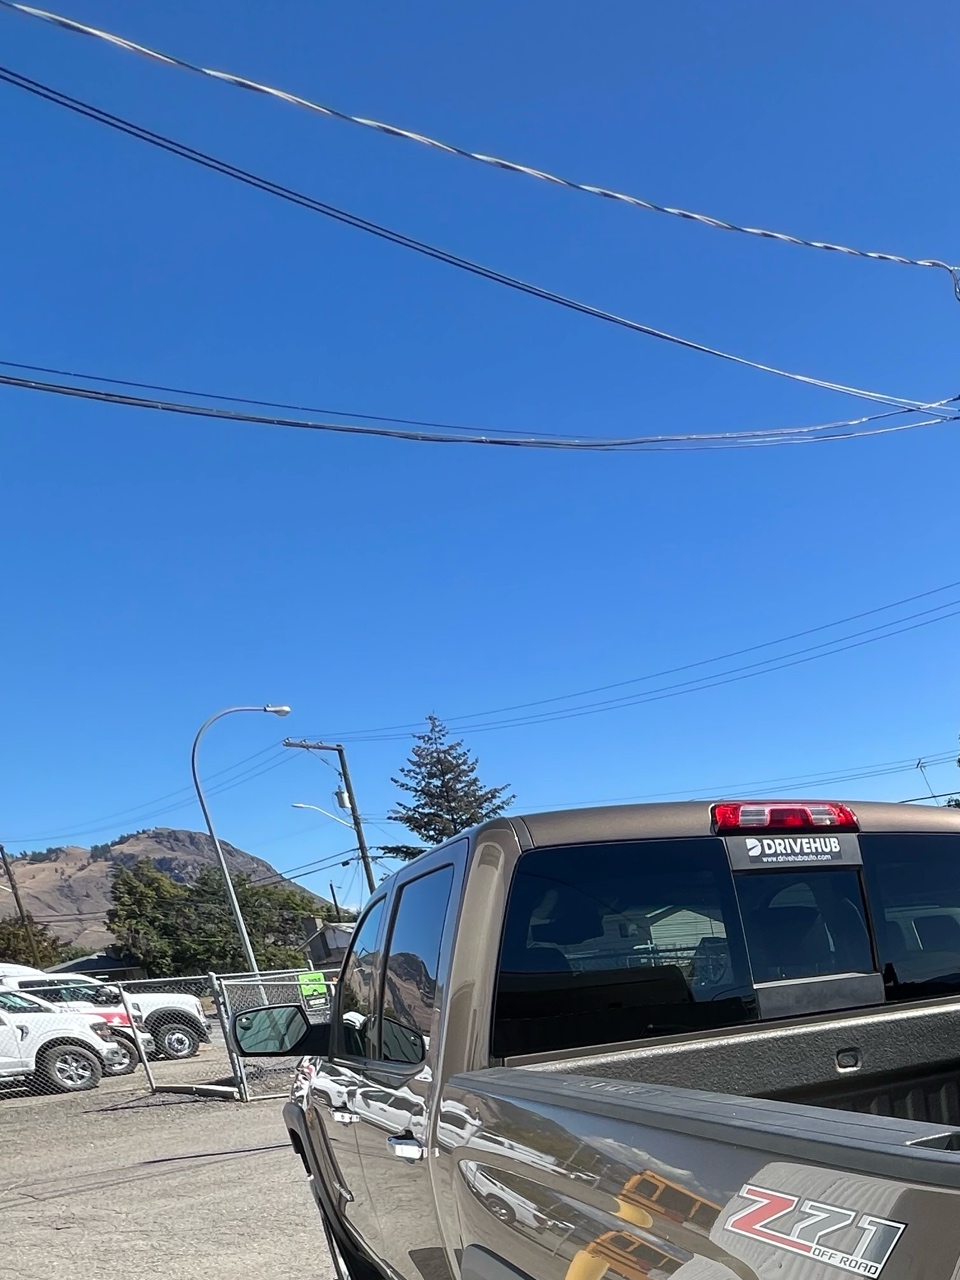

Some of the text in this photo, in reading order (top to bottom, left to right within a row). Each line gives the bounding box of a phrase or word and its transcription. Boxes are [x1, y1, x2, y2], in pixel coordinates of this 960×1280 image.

[763, 837, 840, 855] DRIVEHUB
[762, 854, 831, 863] www.drivehubauto.com
[724, 1183, 908, 1265] Z71
[812, 1248, 878, 1275] OFF ROAD
